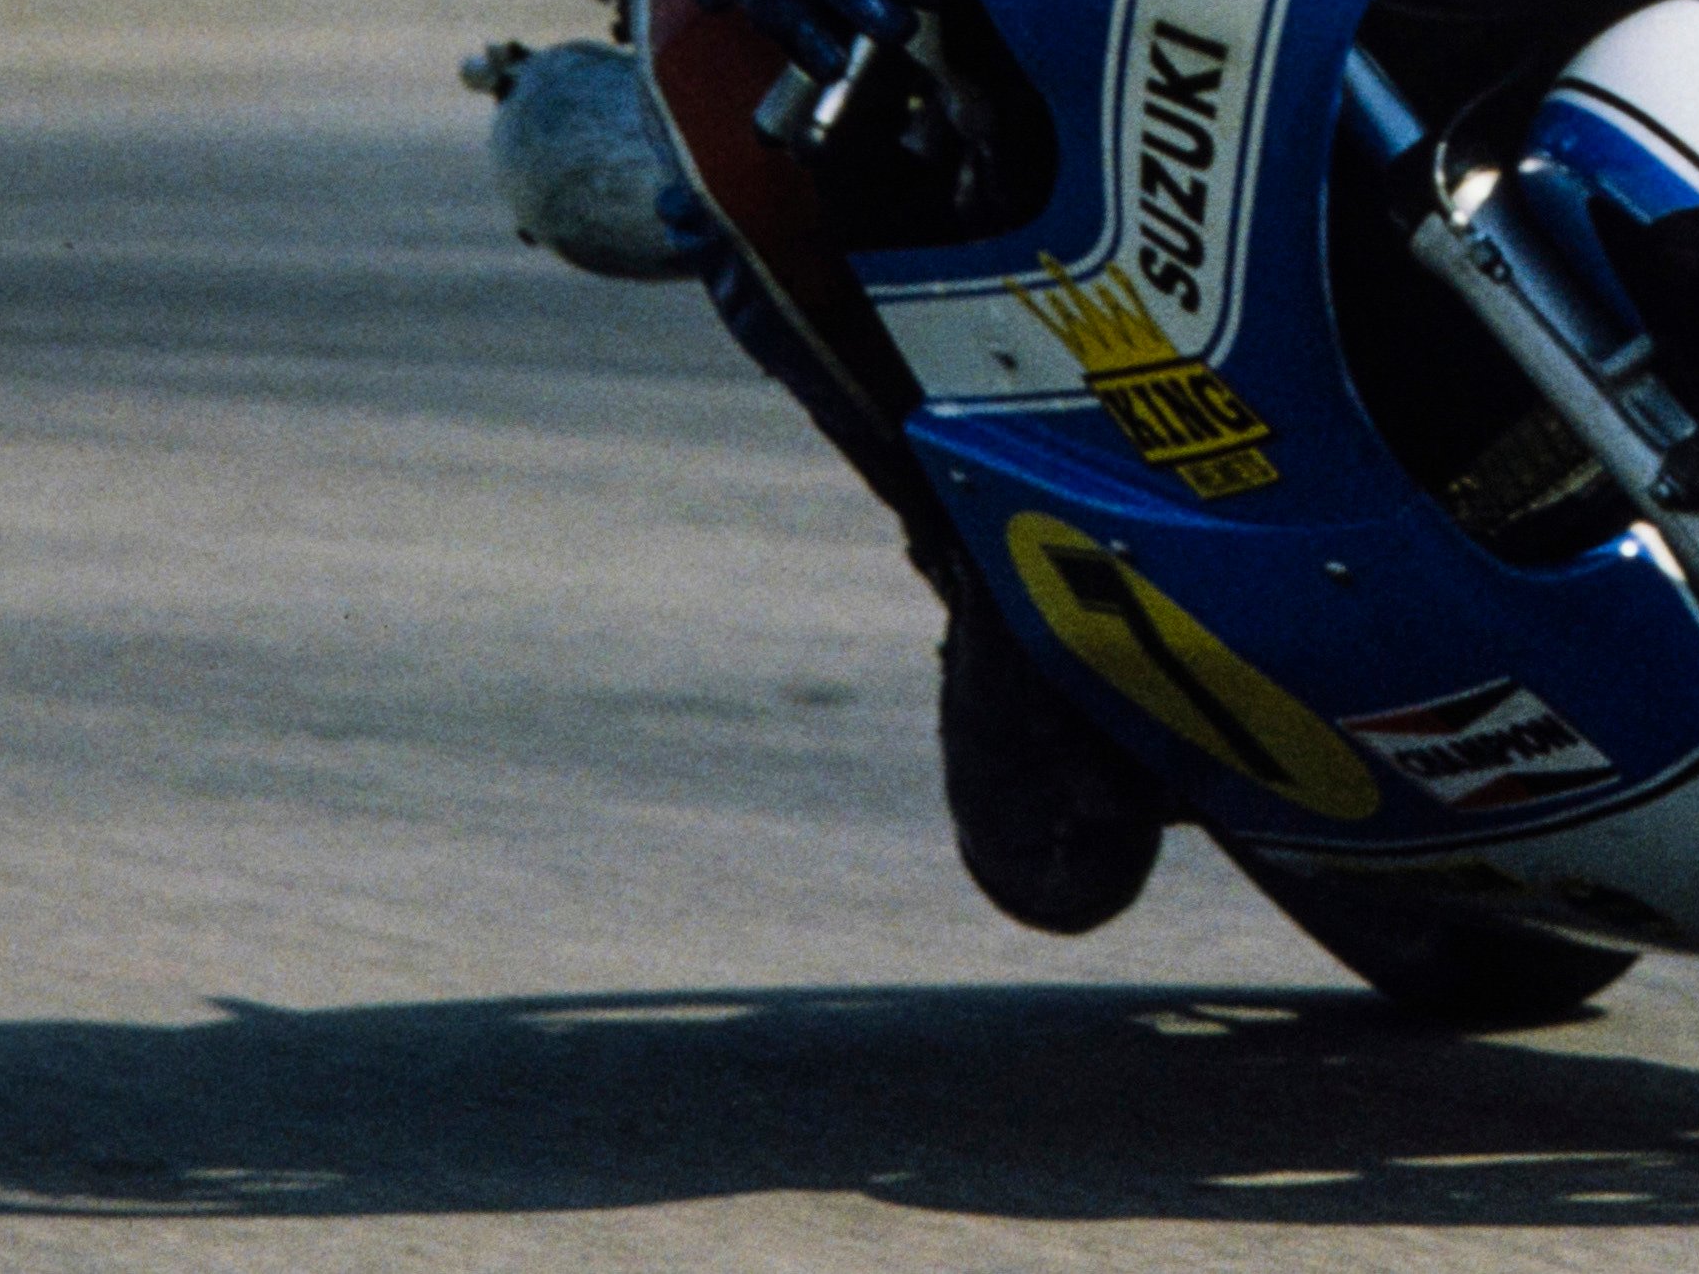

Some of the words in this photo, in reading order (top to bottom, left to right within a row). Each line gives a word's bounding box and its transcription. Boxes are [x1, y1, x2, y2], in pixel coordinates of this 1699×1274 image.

[1138, 19, 1229, 314] SUZUKI
[1102, 373, 1259, 452] KING
[1394, 713, 1580, 779] CHAMPION
